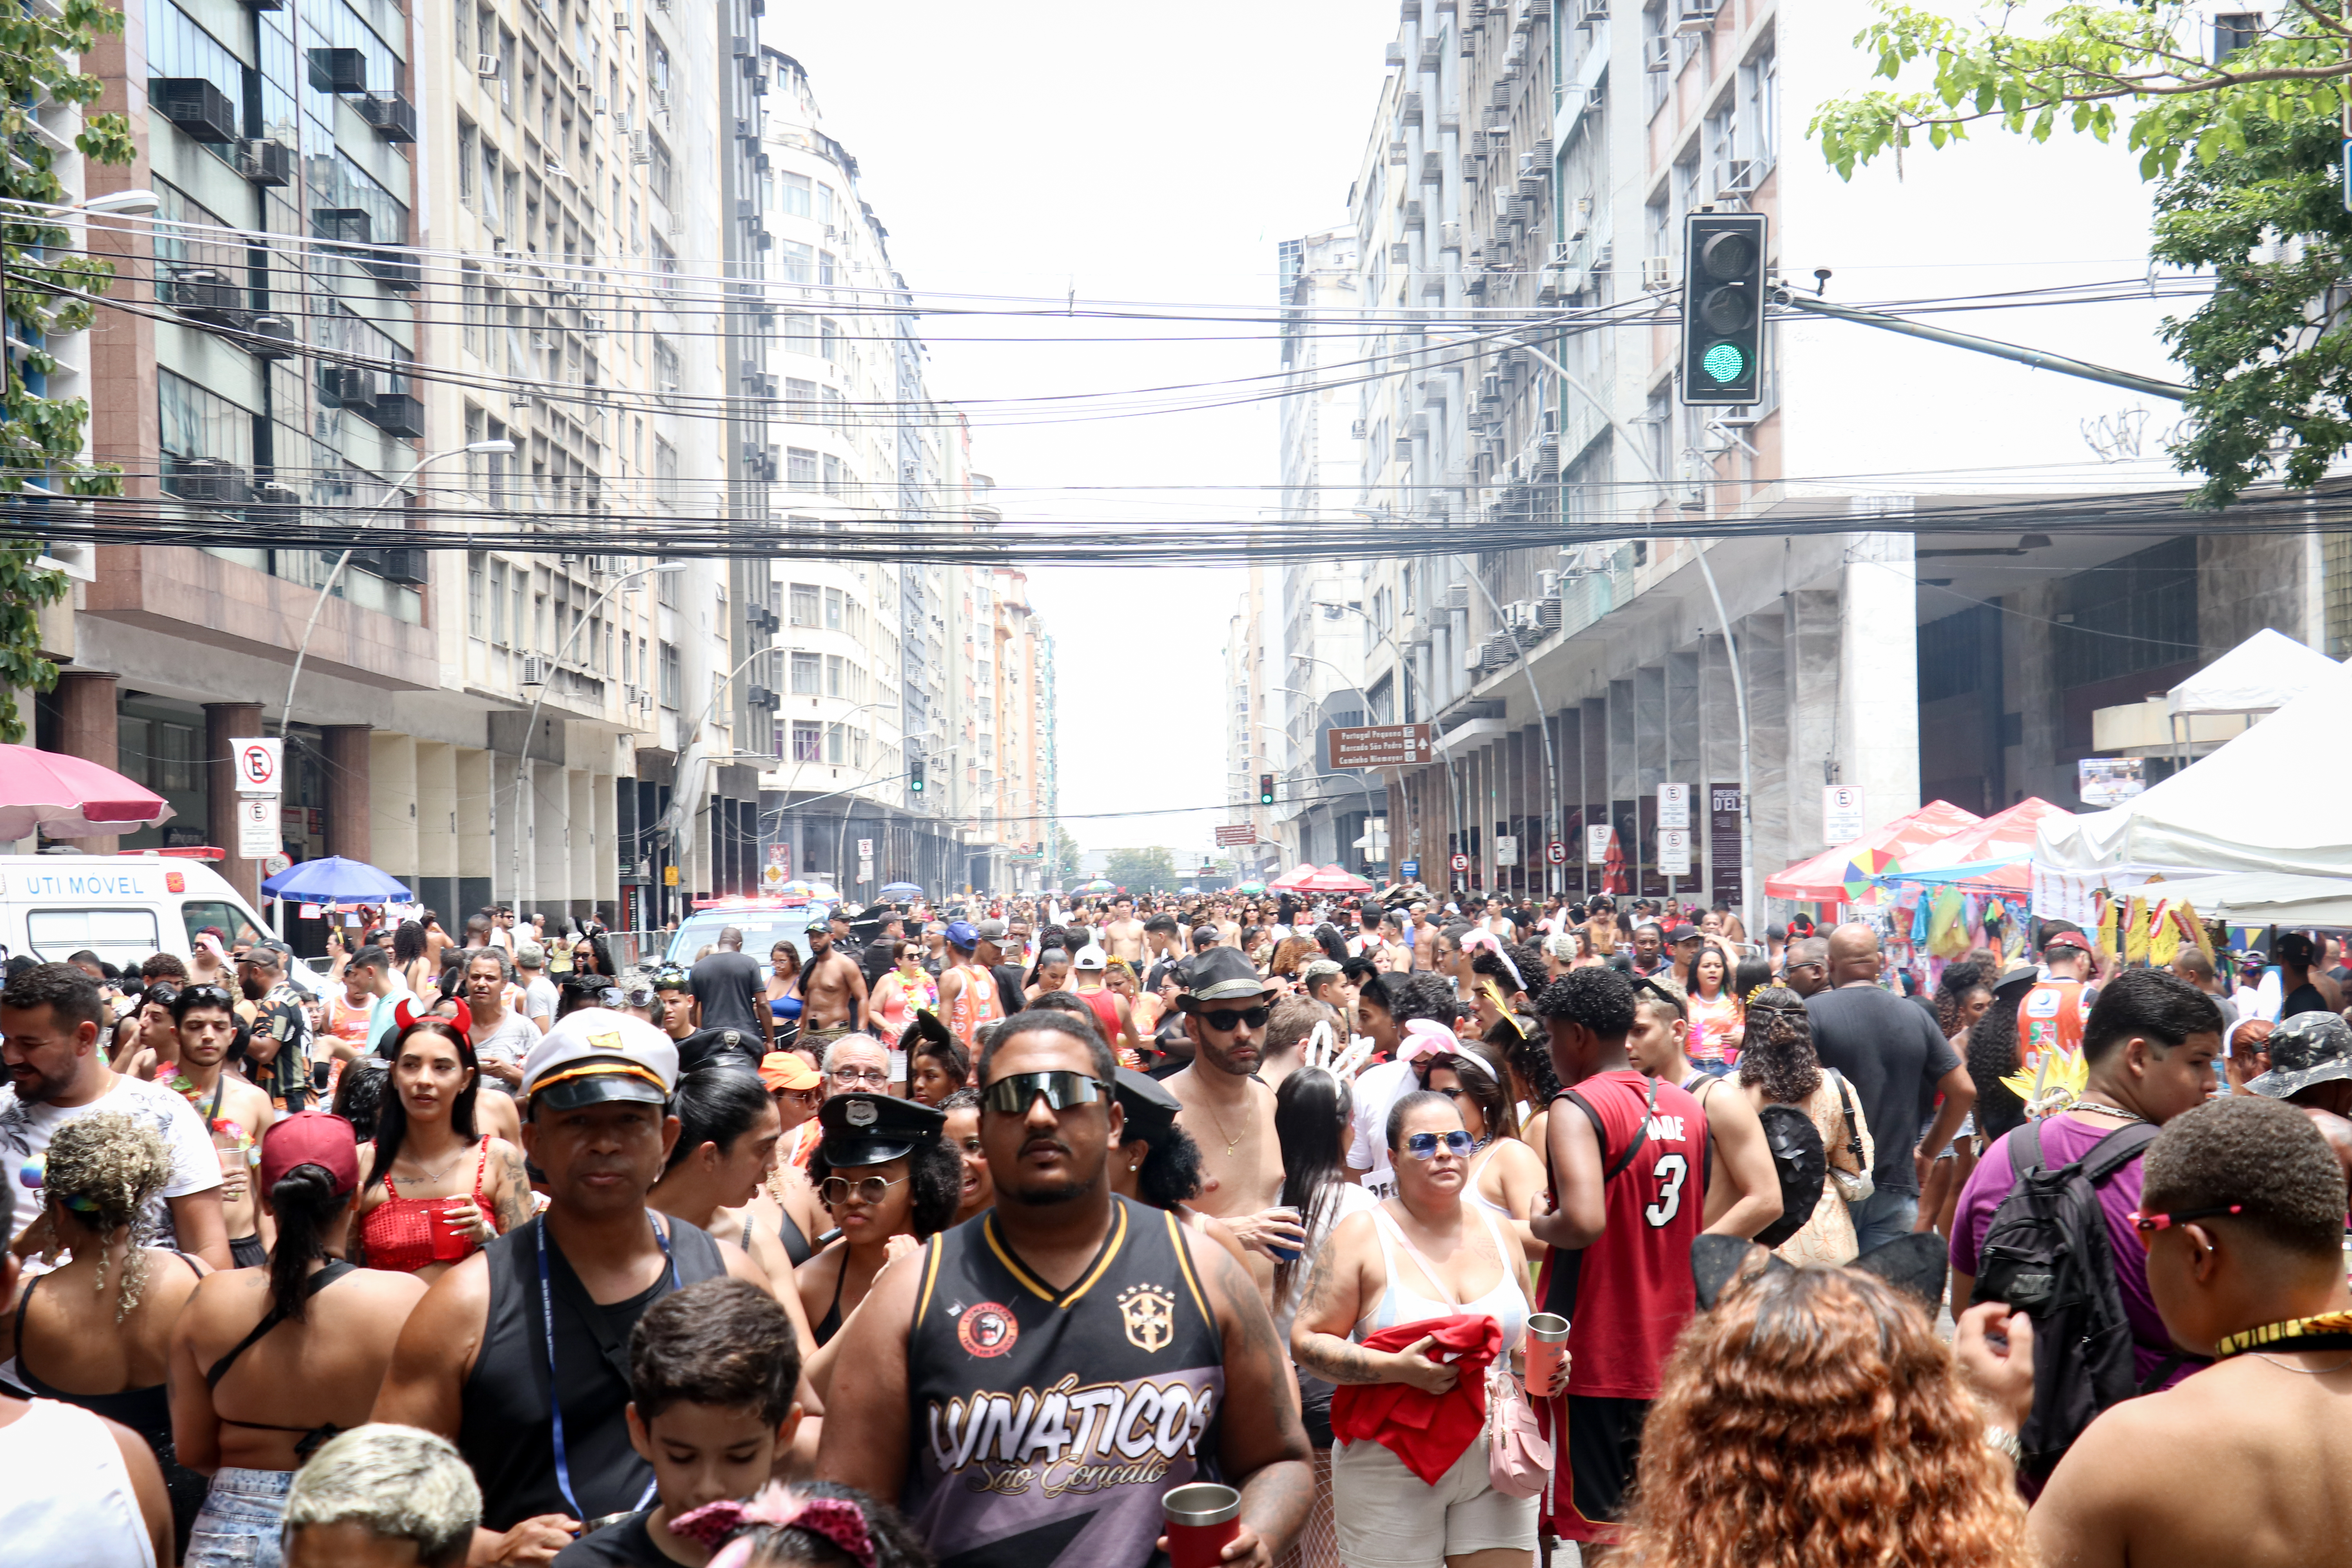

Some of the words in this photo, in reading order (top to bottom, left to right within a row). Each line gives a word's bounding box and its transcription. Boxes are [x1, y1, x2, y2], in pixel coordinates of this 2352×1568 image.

[1341, 731, 1370, 740] Portugal
[1372, 730, 1402, 739] Pequeno
[1340, 743, 1368, 752] Mercado
[251, 753, 264, 776] E
[1339, 755, 1368, 764] Caminho
[1670, 789, 1677, 798] E
[1839, 792, 1848, 804] E
[254, 806, 263, 818] E
[1671, 835, 1678, 844] E
[1553, 846, 1562, 860] E
[1456, 857, 1464, 868] E
[27, 877, 61, 894] UTI
[69, 872, 144, 894] MÓVEL
[1646, 1153, 1688, 1228] 3
[929, 1374, 1213, 1473] LUNÁTICOS
[965, 1456, 1037, 1496] São
[1039, 1454, 1169, 1499] Gonçalo
